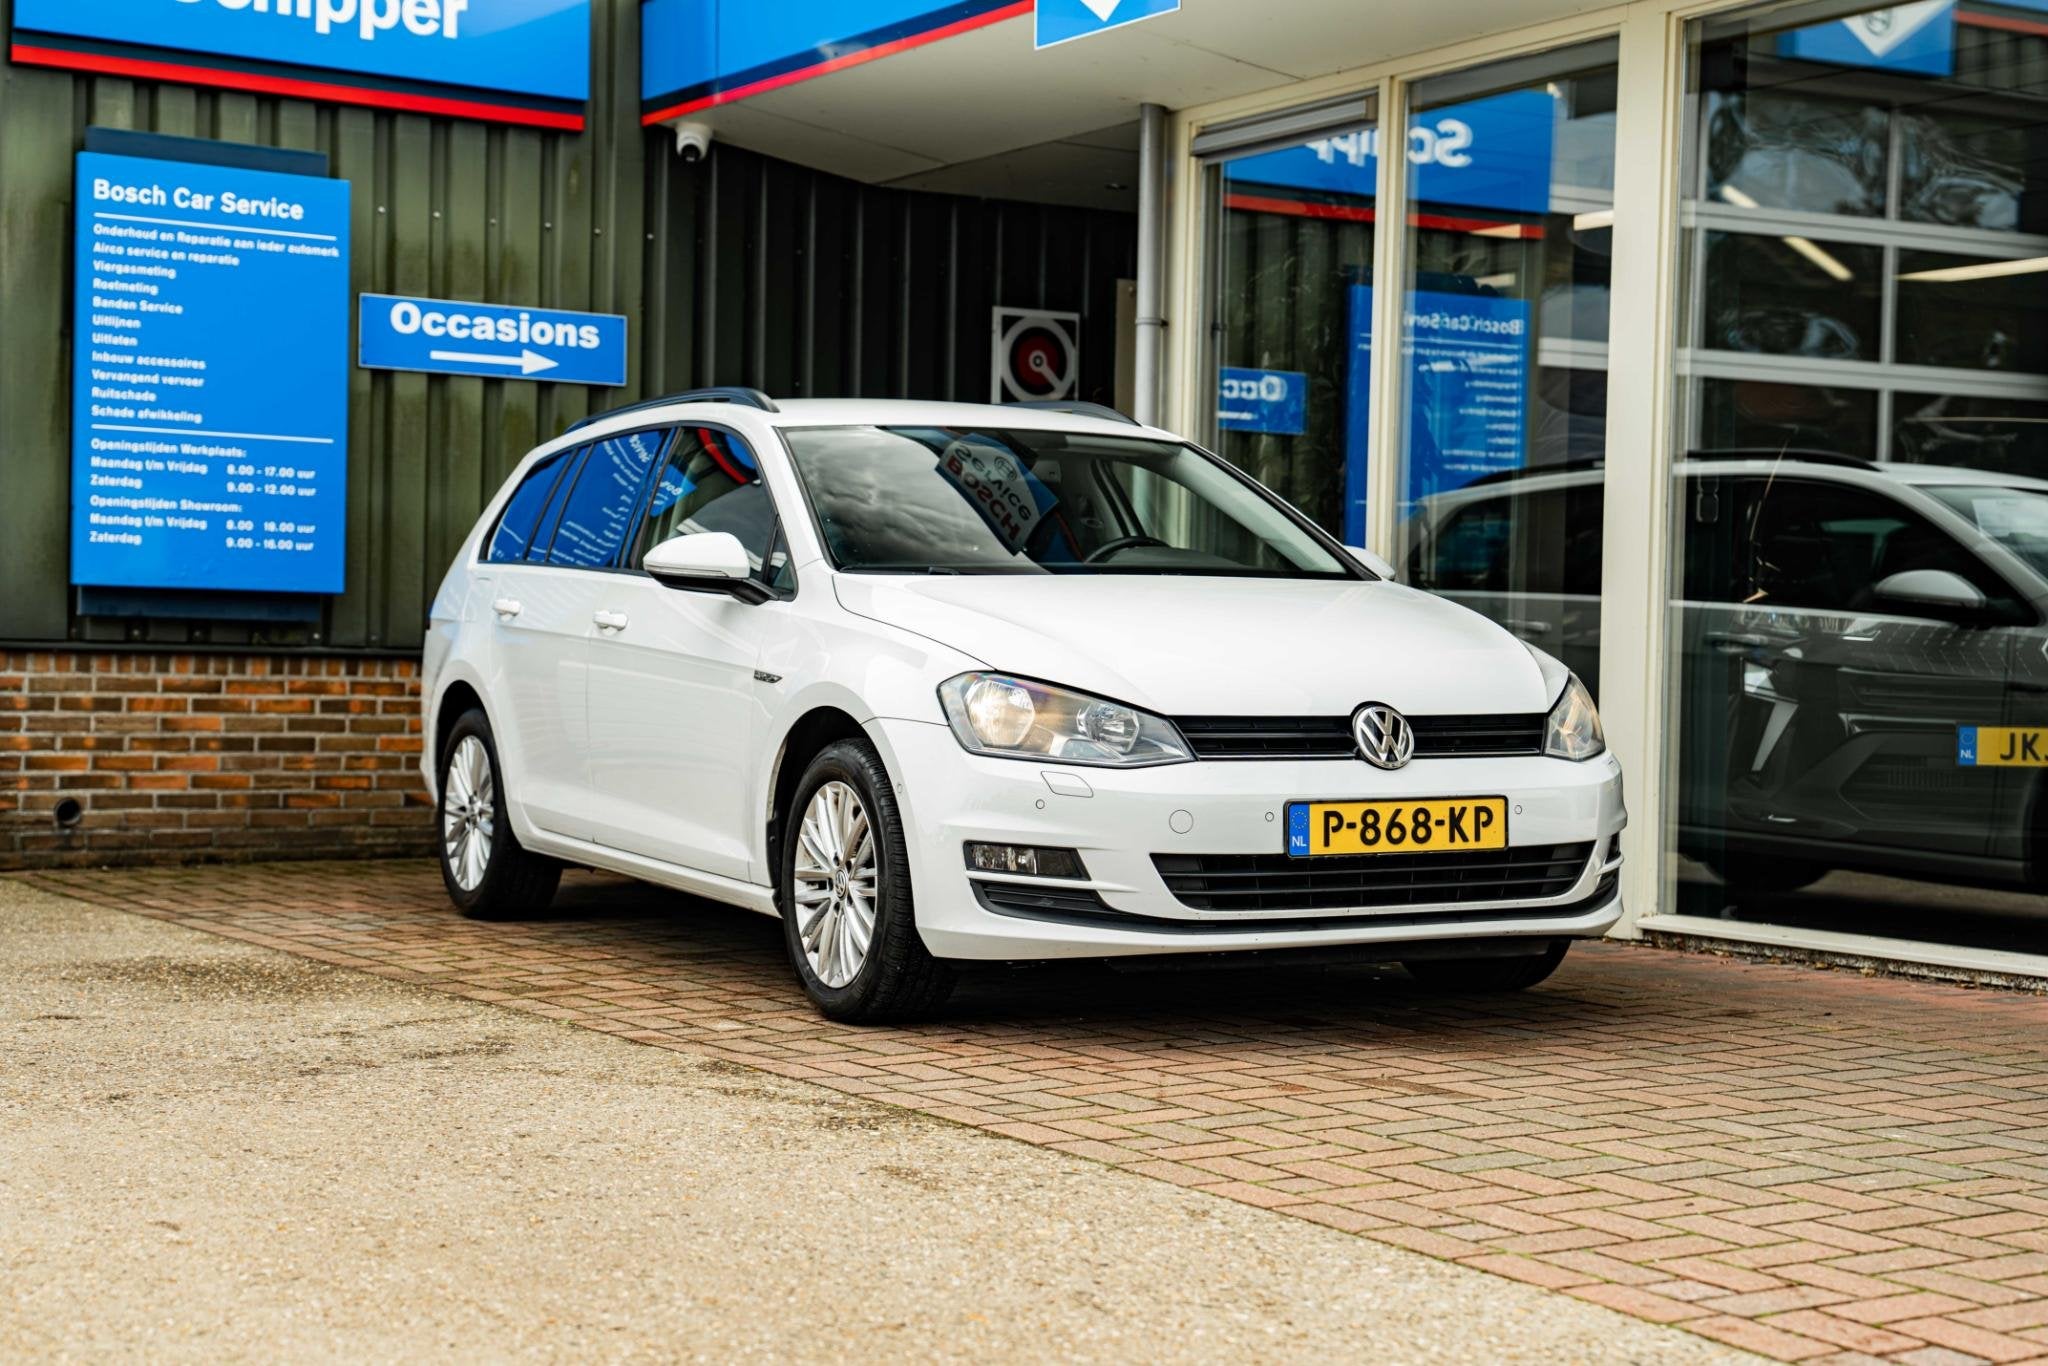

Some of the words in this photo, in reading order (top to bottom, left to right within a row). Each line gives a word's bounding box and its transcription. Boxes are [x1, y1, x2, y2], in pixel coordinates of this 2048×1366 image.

[94, 178, 166, 206] Bosch
[173, 187, 214, 210] Car
[221, 192, 304, 220] Service
[93, 223, 157, 240] Onderhoud
[159, 232, 175, 241] en
[177, 231, 231, 247] Reparatie
[256, 240, 285, 252] ieder
[288, 244, 339, 257] automerk
[93, 242, 124, 255] Airco
[127, 247, 169, 259] service
[171, 251, 186, 260] en
[188, 253, 240, 266] reparatie
[93, 260, 176, 279] Viergasmeting
[93, 296, 137, 310] Banden
[139, 300, 183, 314] Service
[92, 315, 141, 328] Uitlijnen
[390, 302, 600, 349] Occasions
[92, 333, 138, 346] Uitlaten
[92, 351, 134, 364] Inbouw
[137, 356, 206, 369] accessoires
[92, 369, 159, 384] Vervangend
[161, 376, 204, 387] vervoer
[92, 387, 156, 401] Ruitschade
[91, 405, 135, 418] Schade
[137, 408, 202, 424] afwikkeling
[91, 438, 178, 453] Openingstijden
[180, 444, 246, 457] Werkplaats:
[91, 456, 143, 471] Maandag
[145, 460, 165, 470] t/m
[167, 461, 208, 474] Vrijdag
[265, 466, 295, 478] 17.00
[297, 471, 315, 479] uur
[90, 474, 142, 489] Zaterdag
[264, 484, 296, 495] 12.00
[298, 488, 316, 496] uur
[90, 495, 177, 510] Openingstijden
[180, 499, 241, 512] Showroom:
[90, 513, 143, 528] Maandag
[144, 516, 164, 527] t/m
[166, 516, 207, 530] Vrijdag
[90, 531, 142, 545] Zaterdag
[295, 543, 313, 551] uur
[1960, 749, 1974, 759] NL
[2000, 732, 2048, 761] JK
[1323, 806, 1494, 847] P-868-KP
[1292, 836, 1306, 847] NL
